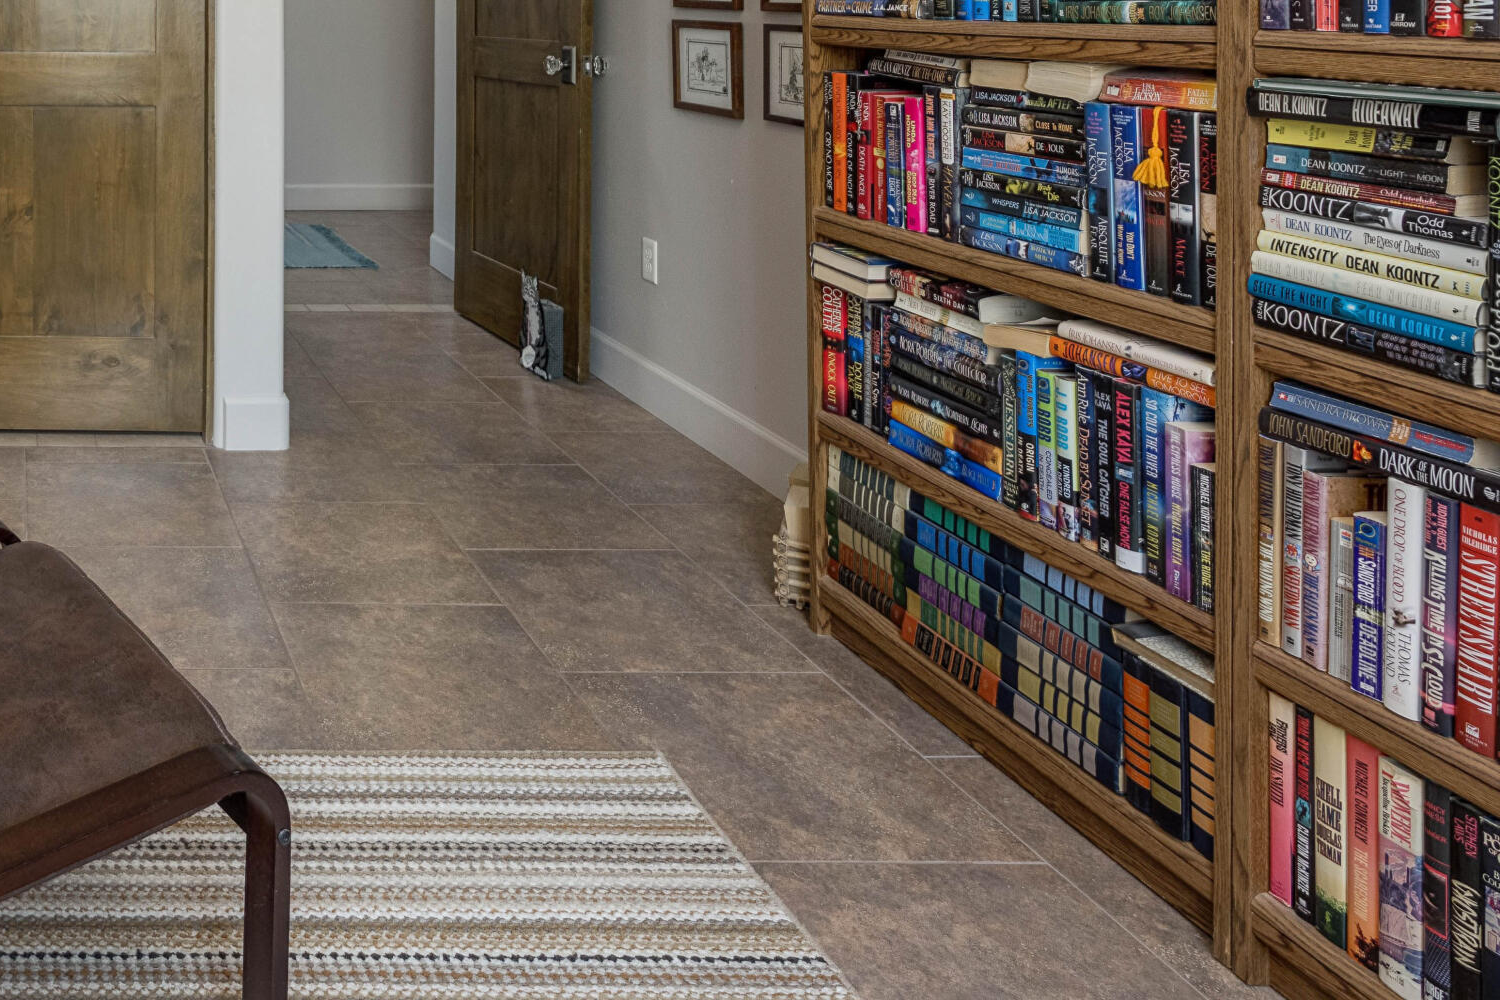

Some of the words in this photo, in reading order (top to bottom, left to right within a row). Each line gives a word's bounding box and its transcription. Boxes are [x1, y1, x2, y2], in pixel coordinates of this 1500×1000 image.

[1434, 0, 1452, 19] 101
[1258, 93, 1282, 112] DEAN
[1283, 96, 1291, 113] R.
[1291, 95, 1328, 117] KOONTZ
[1352, 99, 1423, 129] HIDEAWAY
[1087, 137, 1098, 185] JACKSON
[1097, 151, 1108, 173] LISA
[991, 197, 1020, 210] WHISPERS
[1024, 206, 1039, 216] LISA
[1039, 209, 1077, 224] JACKSON
[1267, 189, 1353, 221] KOONTZ
[1090, 225, 1098, 248] FEAR
[1285, 217, 1311, 232] DEAN
[1314, 222, 1353, 242] KOONTZ
[1363, 232, 1376, 245] The
[1376, 236, 1394, 248] Eyes
[1394, 236, 1402, 248] of
[1403, 239, 1441, 259] Darkness
[1406, 221, 1454, 239] Thomas
[1416, 214, 1445, 228] Odd
[1098, 217, 1108, 265] ABSOLUTE
[1270, 237, 1339, 264] INTENSITY
[1345, 255, 1380, 275] DEAN
[1386, 263, 1440, 289] KOONTZ
[822, 286, 832, 331] COULTER
[832, 288, 843, 334] CATHERINE
[1115, 390, 1132, 424] ALEX
[1116, 425, 1134, 463] KAVA
[1269, 413, 1293, 437] JOHN
[1296, 421, 1350, 457] SANDFORD
[1379, 448, 1416, 480] DARK
[1416, 470, 1429, 484] THE
[1418, 461, 1427, 472] OF
[1429, 463, 1476, 499] MOON
[1458, 551, 1498, 715] STREETSMART
[1316, 776, 1342, 811] SHELL
[1316, 798, 1342, 832] GAME
[1316, 824, 1342, 848] DOUGLAS
[1316, 840, 1342, 867] TERMAN
